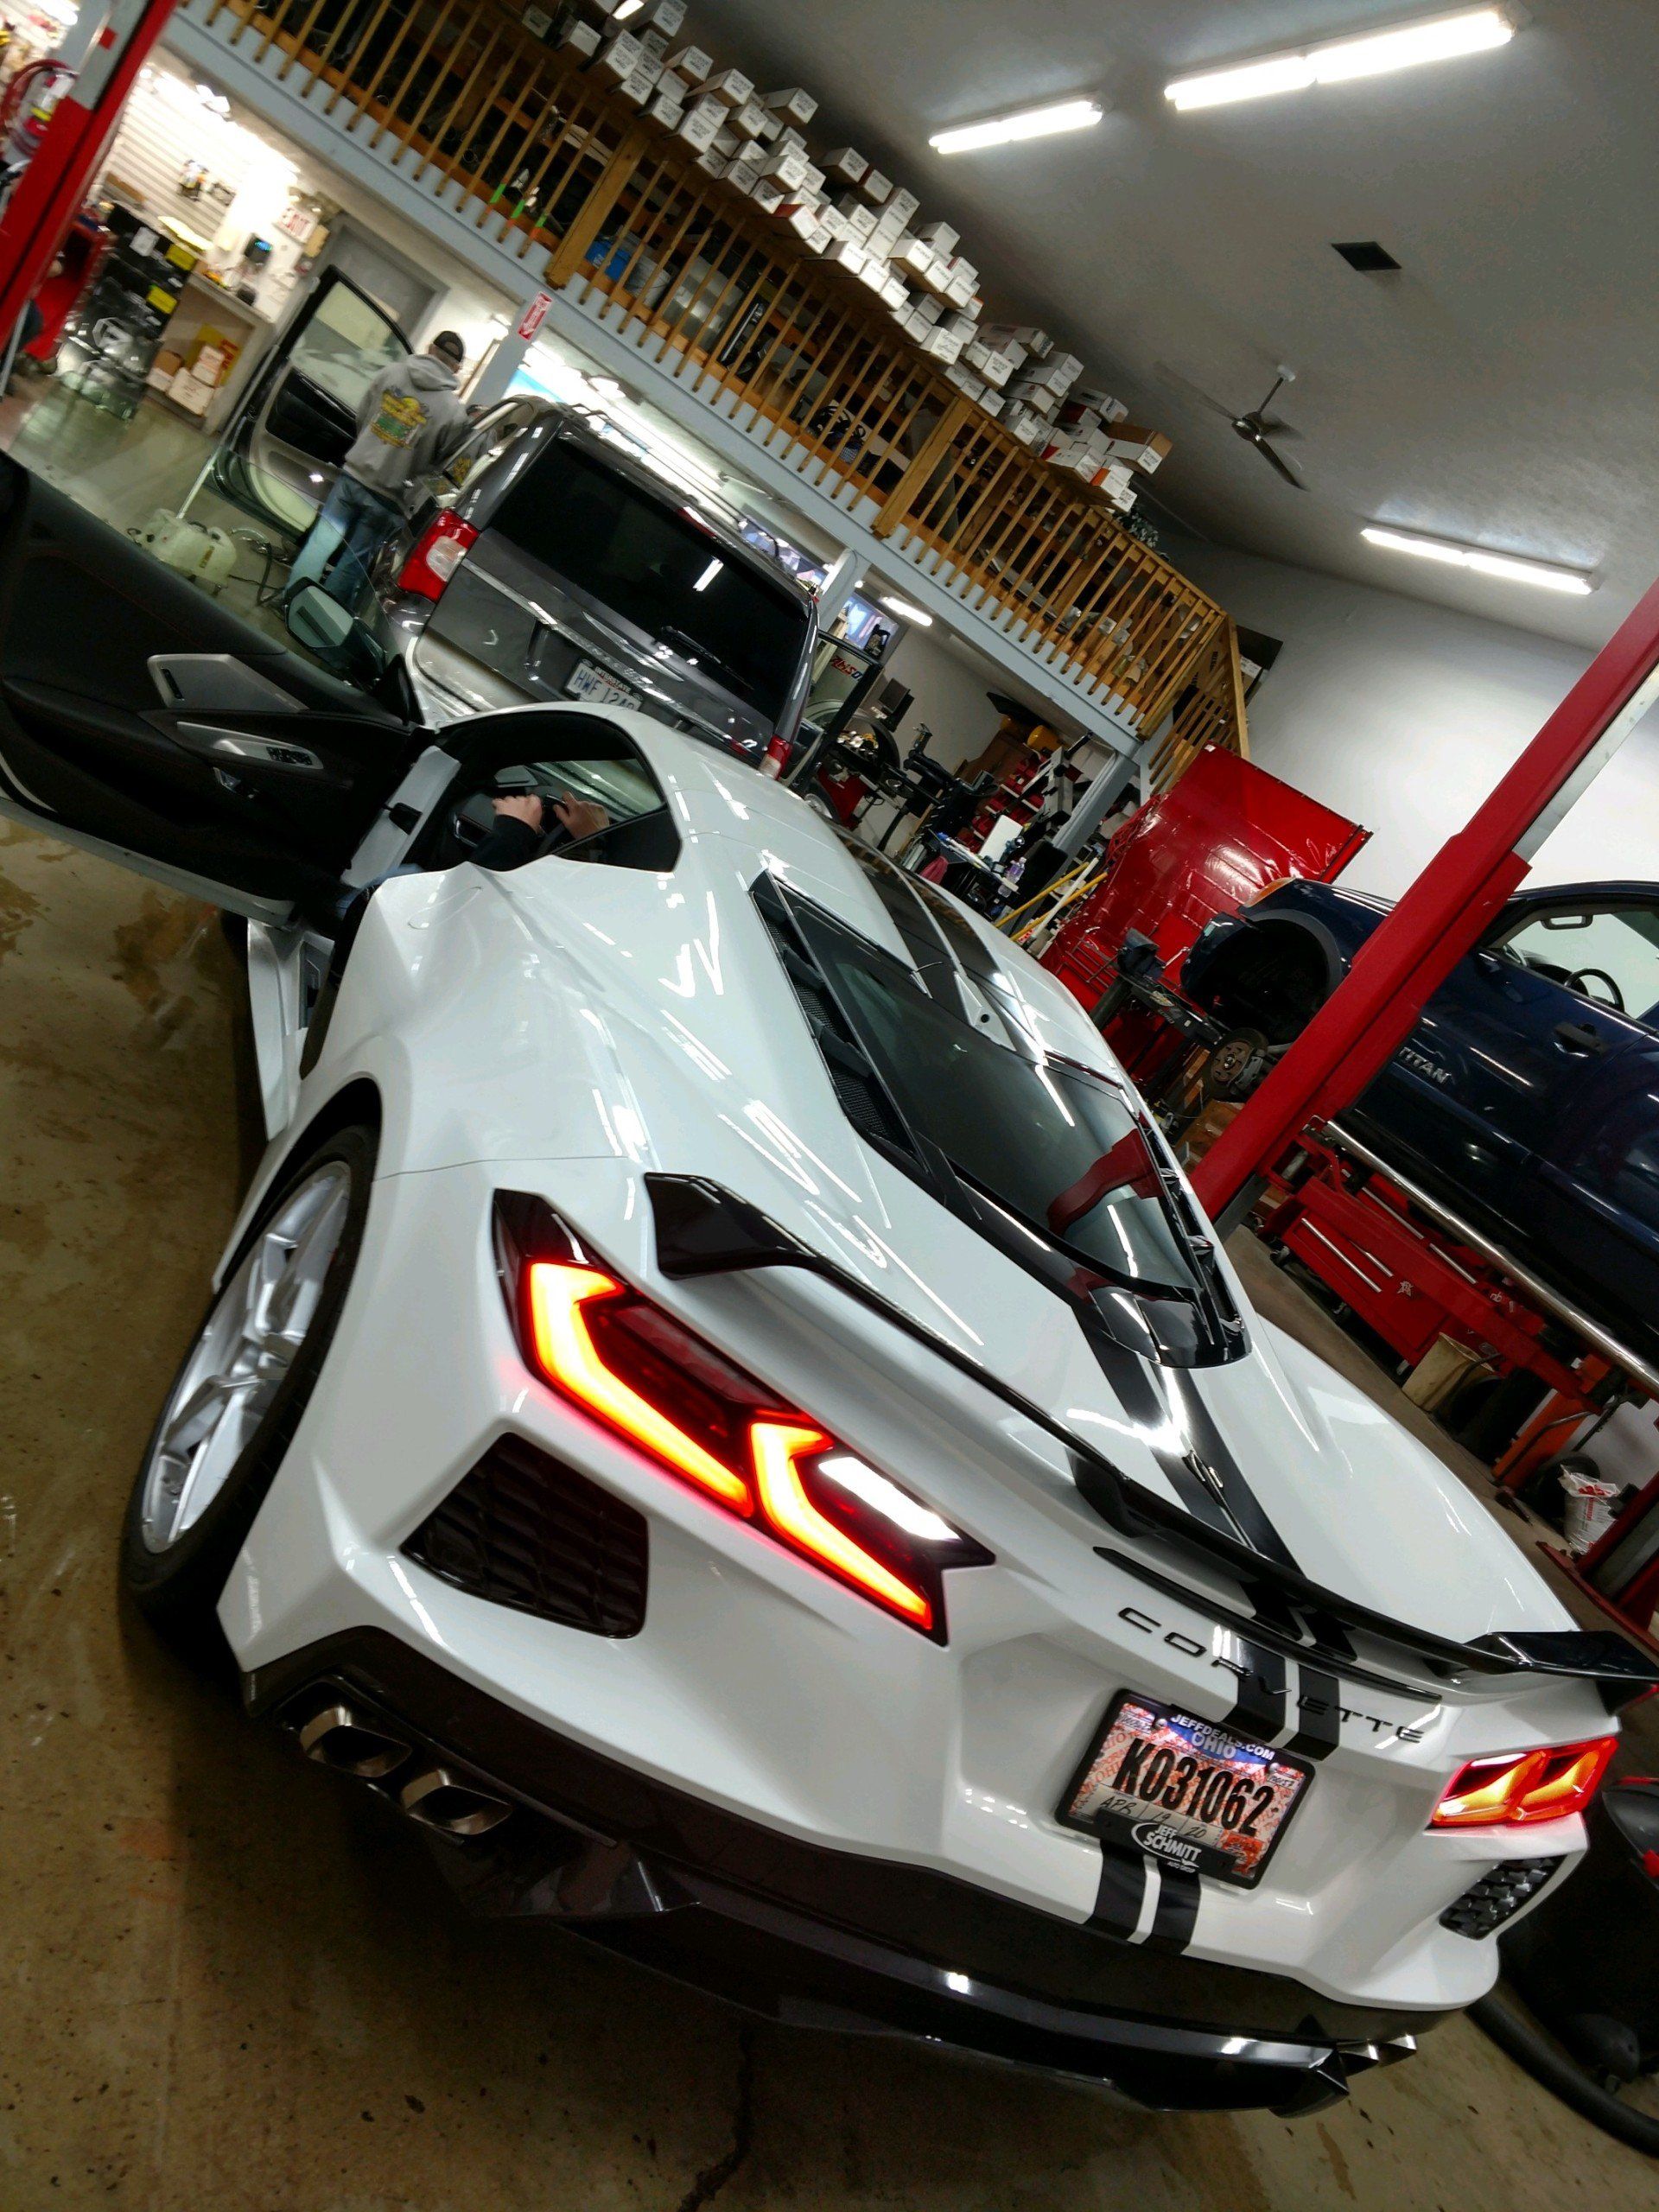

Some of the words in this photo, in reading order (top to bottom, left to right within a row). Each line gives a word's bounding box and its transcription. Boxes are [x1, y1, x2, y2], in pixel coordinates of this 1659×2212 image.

[1399, 1046, 1452, 1084] TITAN
[1118, 1607, 1424, 1743] CORVETTE
[1170, 1714, 1275, 1761] JEFFDEALS.COM
[1191, 1732, 1236, 1759] OHIO
[1111, 1738, 1274, 1835] K031062
[1143, 1833, 1202, 1861] SCHMITT
[1154, 1823, 1177, 1840] JEFF
[1185, 1826, 1207, 1839] 20
